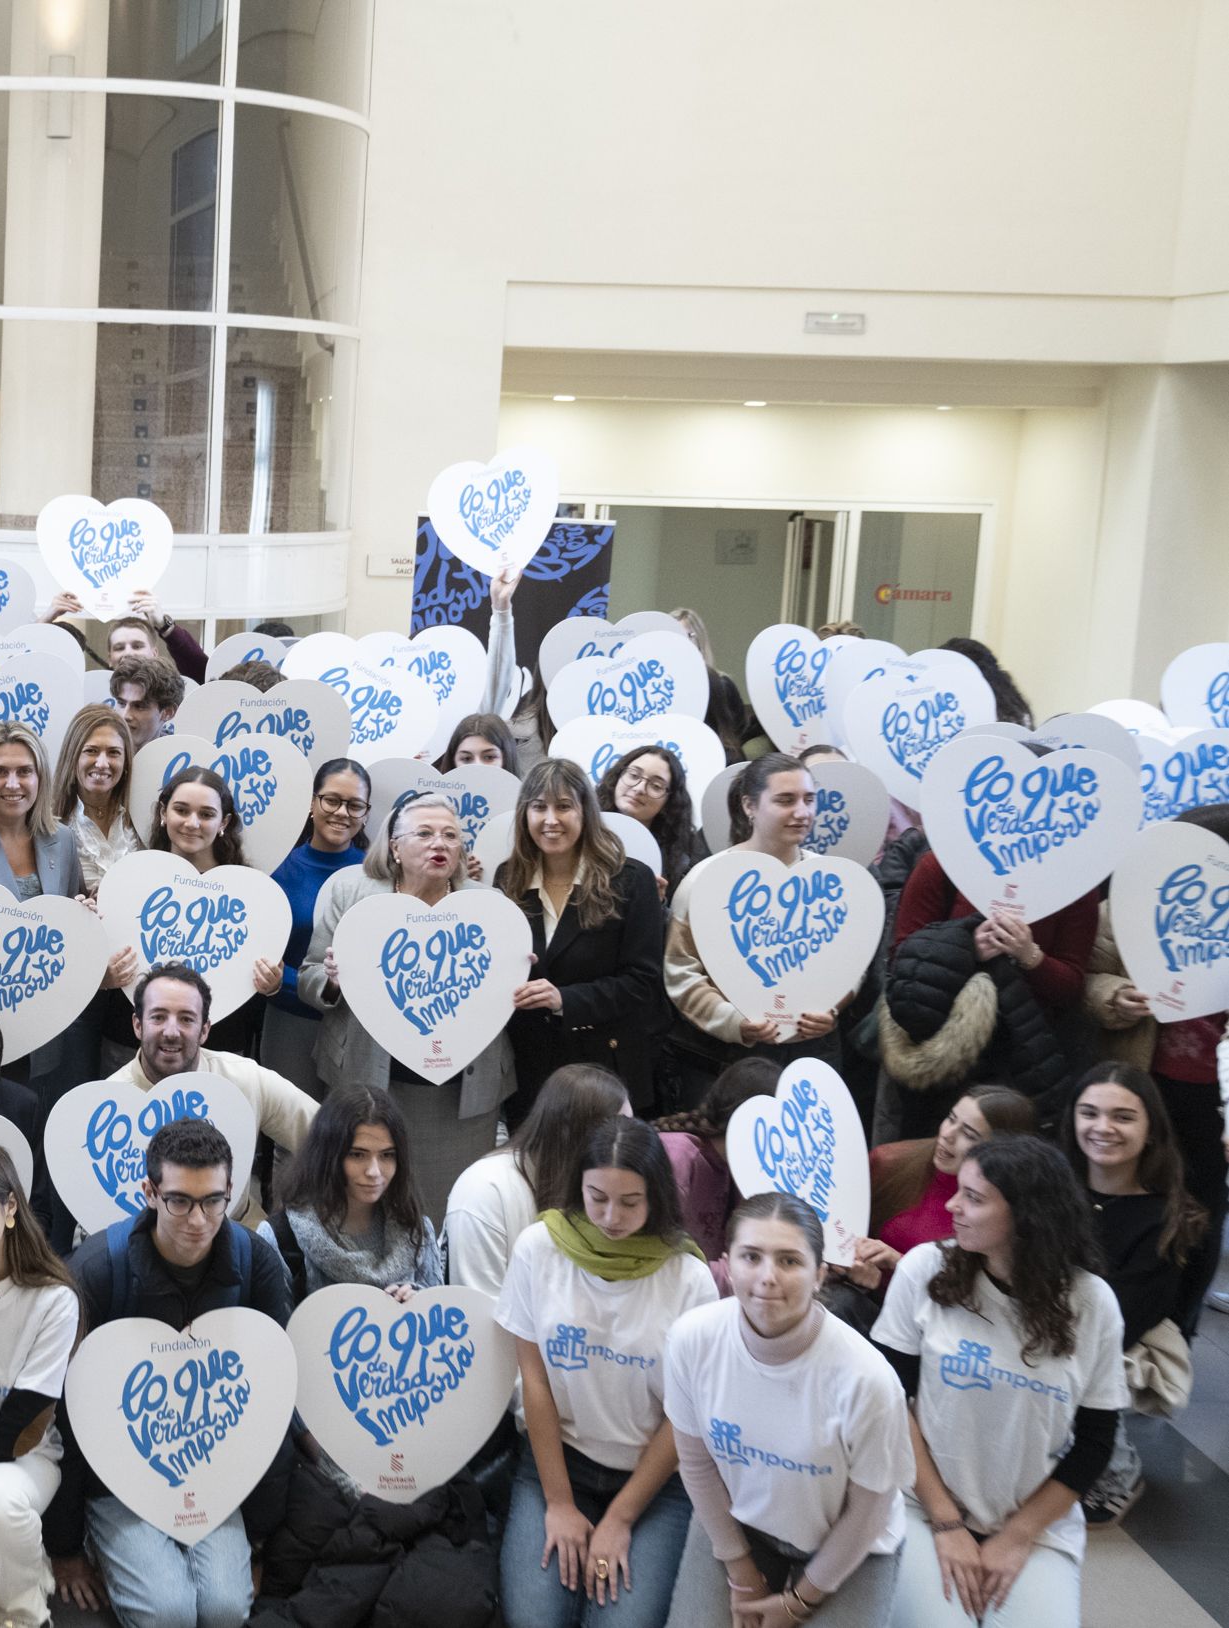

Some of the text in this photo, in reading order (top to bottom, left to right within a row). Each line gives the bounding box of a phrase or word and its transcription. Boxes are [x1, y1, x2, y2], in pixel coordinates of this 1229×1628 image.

[240, 697, 287, 707] Fundación
[417, 778, 466, 790] Fundación
[174, 874, 224, 892] Fundación
[405, 911, 458, 923] Fundación
[150, 1337, 211, 1353] Fundación
